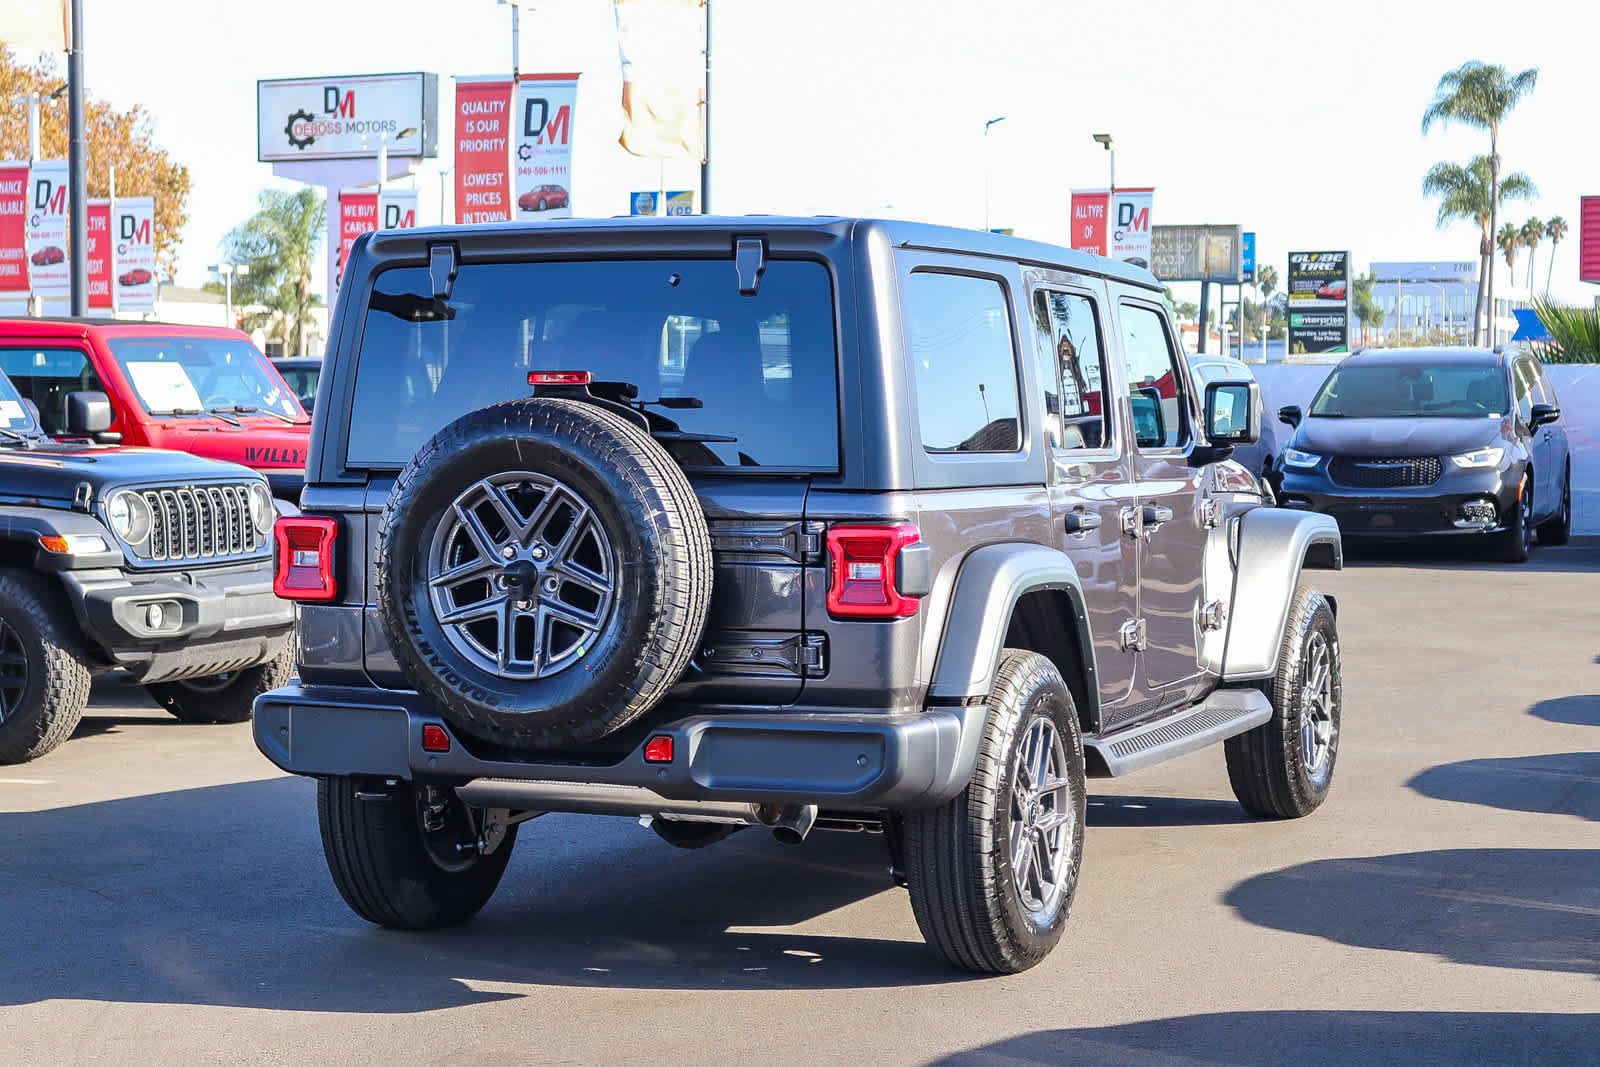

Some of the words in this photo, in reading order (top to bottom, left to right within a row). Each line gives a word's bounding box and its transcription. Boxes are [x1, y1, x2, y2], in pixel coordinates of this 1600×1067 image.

[461, 100, 506, 115] QUALITY
[294, 122, 342, 137] DEBOSS
[345, 119, 397, 134] MOTORS
[465, 120, 475, 133] IS
[477, 119, 500, 133] OUR
[524, 98, 571, 145] DM
[459, 138, 506, 152] PRIORITY
[463, 172, 504, 187] LOWEST
[465, 192, 502, 206] PRICES
[343, 204, 357, 217] WE
[358, 204, 376, 217] BUY
[463, 212, 473, 224] IN
[475, 211, 507, 223] TOWN
[1075, 204, 1088, 219] ALL
[1088, 204, 1104, 219] TYPE
[344, 221, 366, 234] CARS
[1084, 225, 1094, 240] OF
[1300, 262, 1337, 271] TIRE
